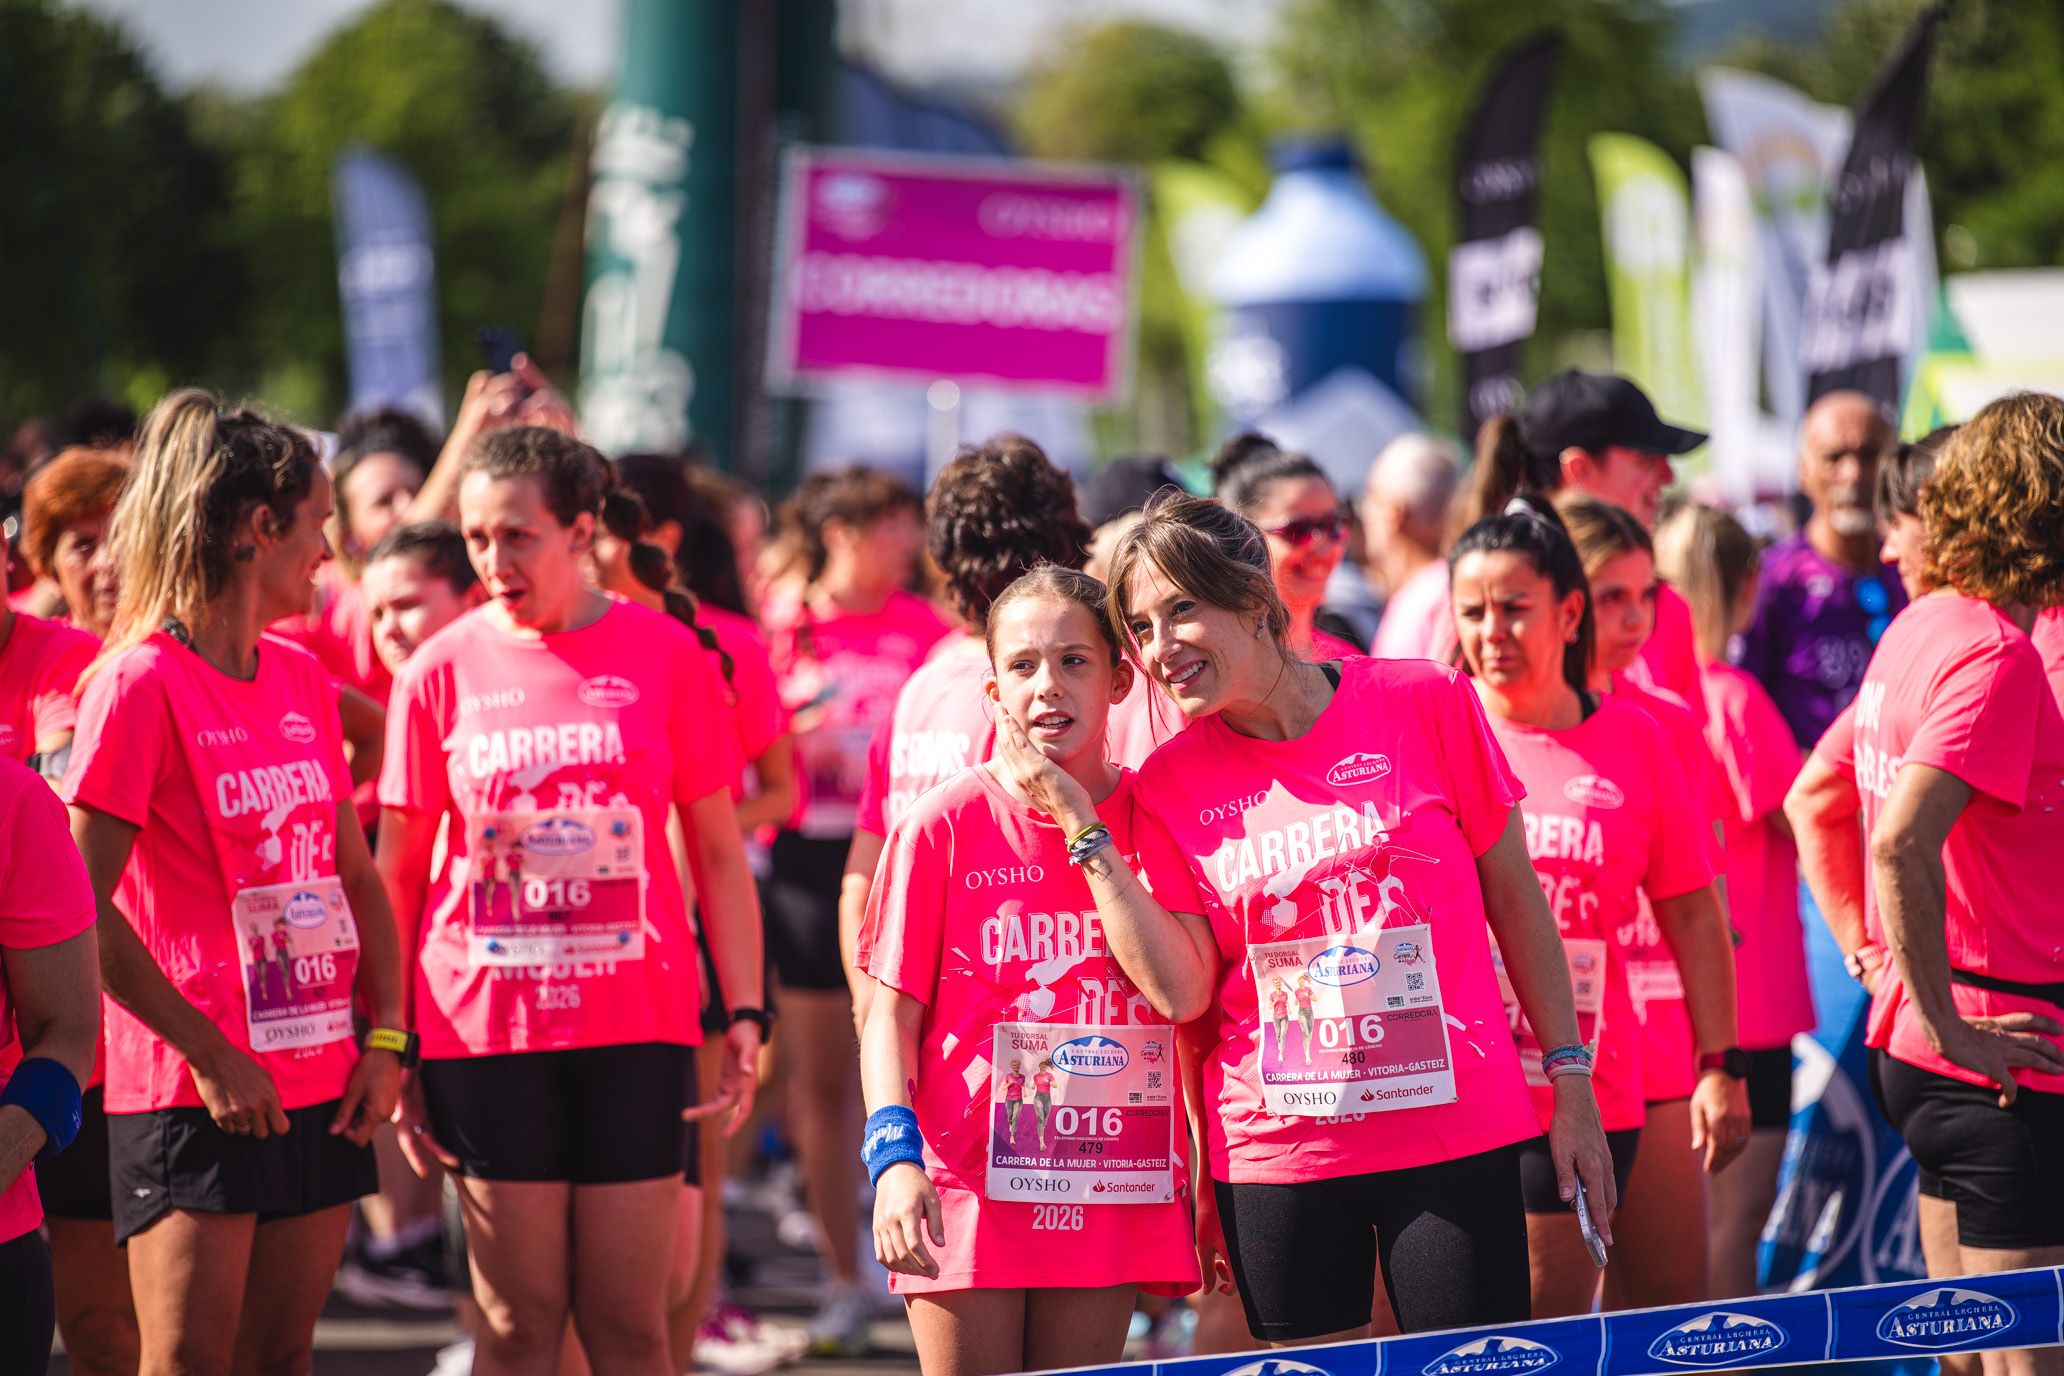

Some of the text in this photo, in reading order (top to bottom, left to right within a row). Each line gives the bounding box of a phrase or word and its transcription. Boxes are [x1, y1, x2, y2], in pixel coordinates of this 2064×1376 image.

[469, 721, 624, 779] CARRERA
[1333, 762, 1389, 783] ASTURIANA
[216, 758, 332, 818] CARRERA
[1200, 790, 1270, 826] OYSHO
[1215, 800, 1389, 893] CARRERA
[966, 865, 1045, 890] OYSHO
[524, 878, 592, 909] 016
[980, 910, 1109, 965] CARRE
[1269, 956, 1303, 968] SUMA
[1274, 950, 1299, 958] DORSAL
[294, 953, 337, 985] 016
[1314, 962, 1375, 978] ASTURIANA
[1387, 1009, 1438, 1021] CORREDORA
[1318, 1014, 1385, 1048] 016
[1012, 1039, 1048, 1050] SUMA
[1058, 1049, 1125, 1067] ASTURIANA
[1341, 1051, 1366, 1064] 480
[1266, 1058, 1446, 1082] CARRERA DE LA MUJER VITORIA-GASTEIZ
[1283, 1091, 1337, 1106] OYSHO
[1376, 1084, 1434, 1101] Santander
[1055, 1107, 1123, 1136] 016
[1126, 1109, 1168, 1117] CORREDORA
[1079, 1142, 1103, 1154] 479
[996, 1156, 1167, 1169] CARRERA DE LA MUJER VITORIA-GASTEIZ
[1010, 1177, 1071, 1193] OYSHO
[1107, 1181, 1155, 1193] Santander
[1032, 1204, 1084, 1231] 2026
[1908, 1305, 2000, 1320] CENTRAL LECHERA
[1886, 1314, 2004, 1339] ASTURIANA
[1680, 1328, 1771, 1343] CENTRAL LECHERA
[1656, 1336, 1773, 1357] ASTURIANA
[1430, 1358, 1545, 1375] ASTURIANA
